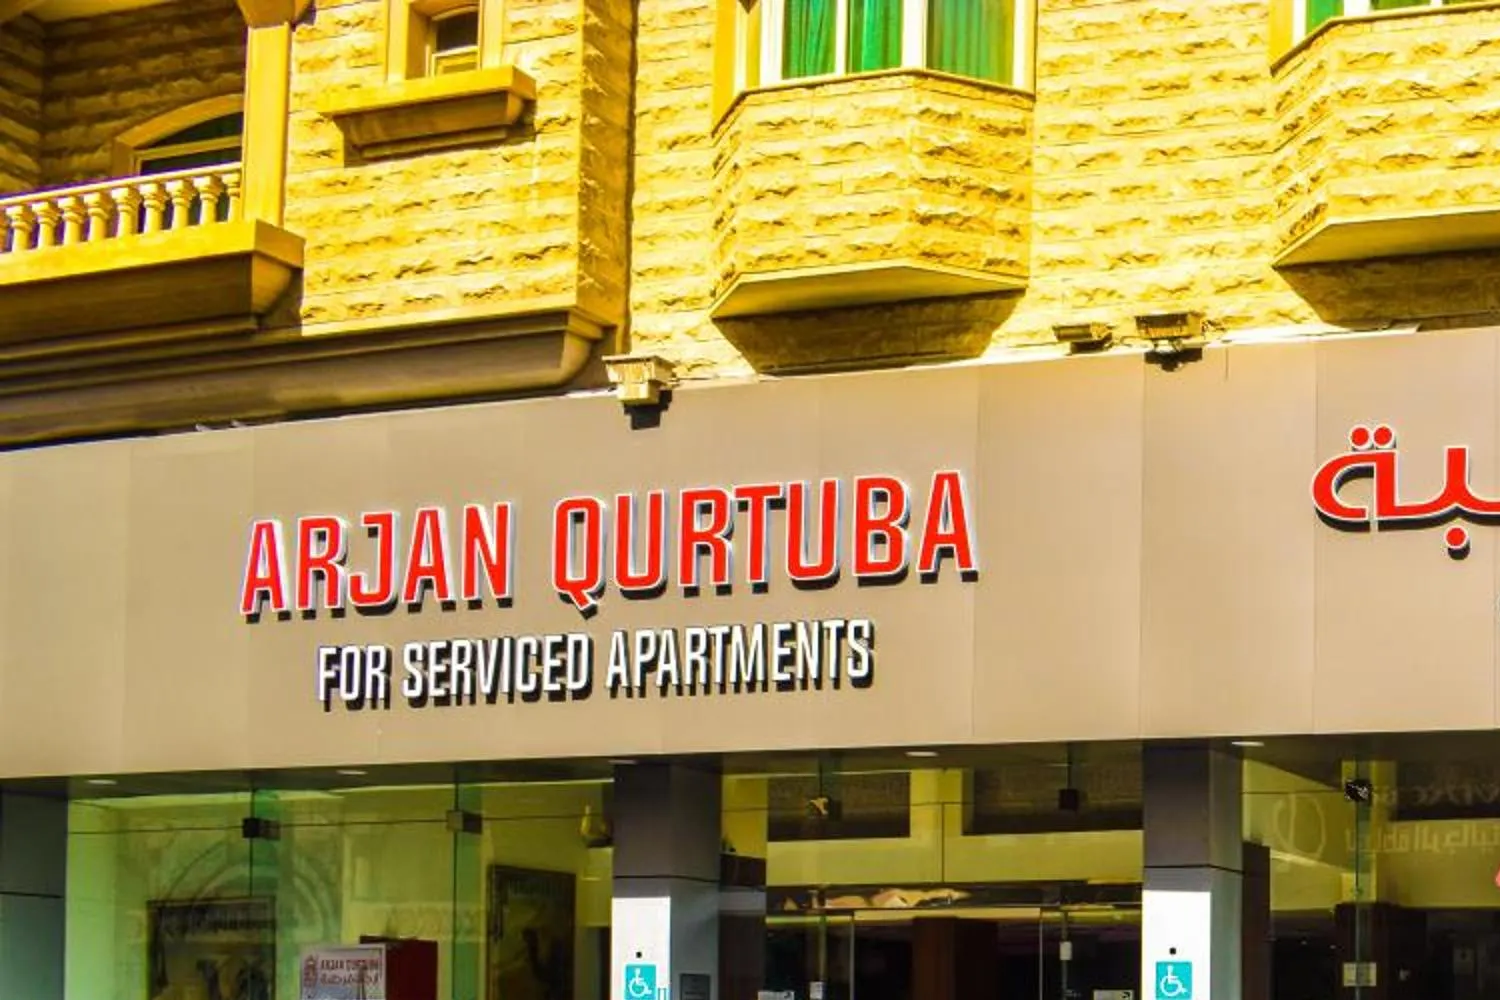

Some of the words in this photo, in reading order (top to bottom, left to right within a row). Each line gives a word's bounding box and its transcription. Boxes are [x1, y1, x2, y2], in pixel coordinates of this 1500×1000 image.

[241, 503, 512, 616] ARJAN
[552, 471, 976, 611] QURTUBA
[318, 645, 390, 706] FOR
[402, 633, 591, 698] SERVICED
[605, 619, 874, 690] APARTMENTS
